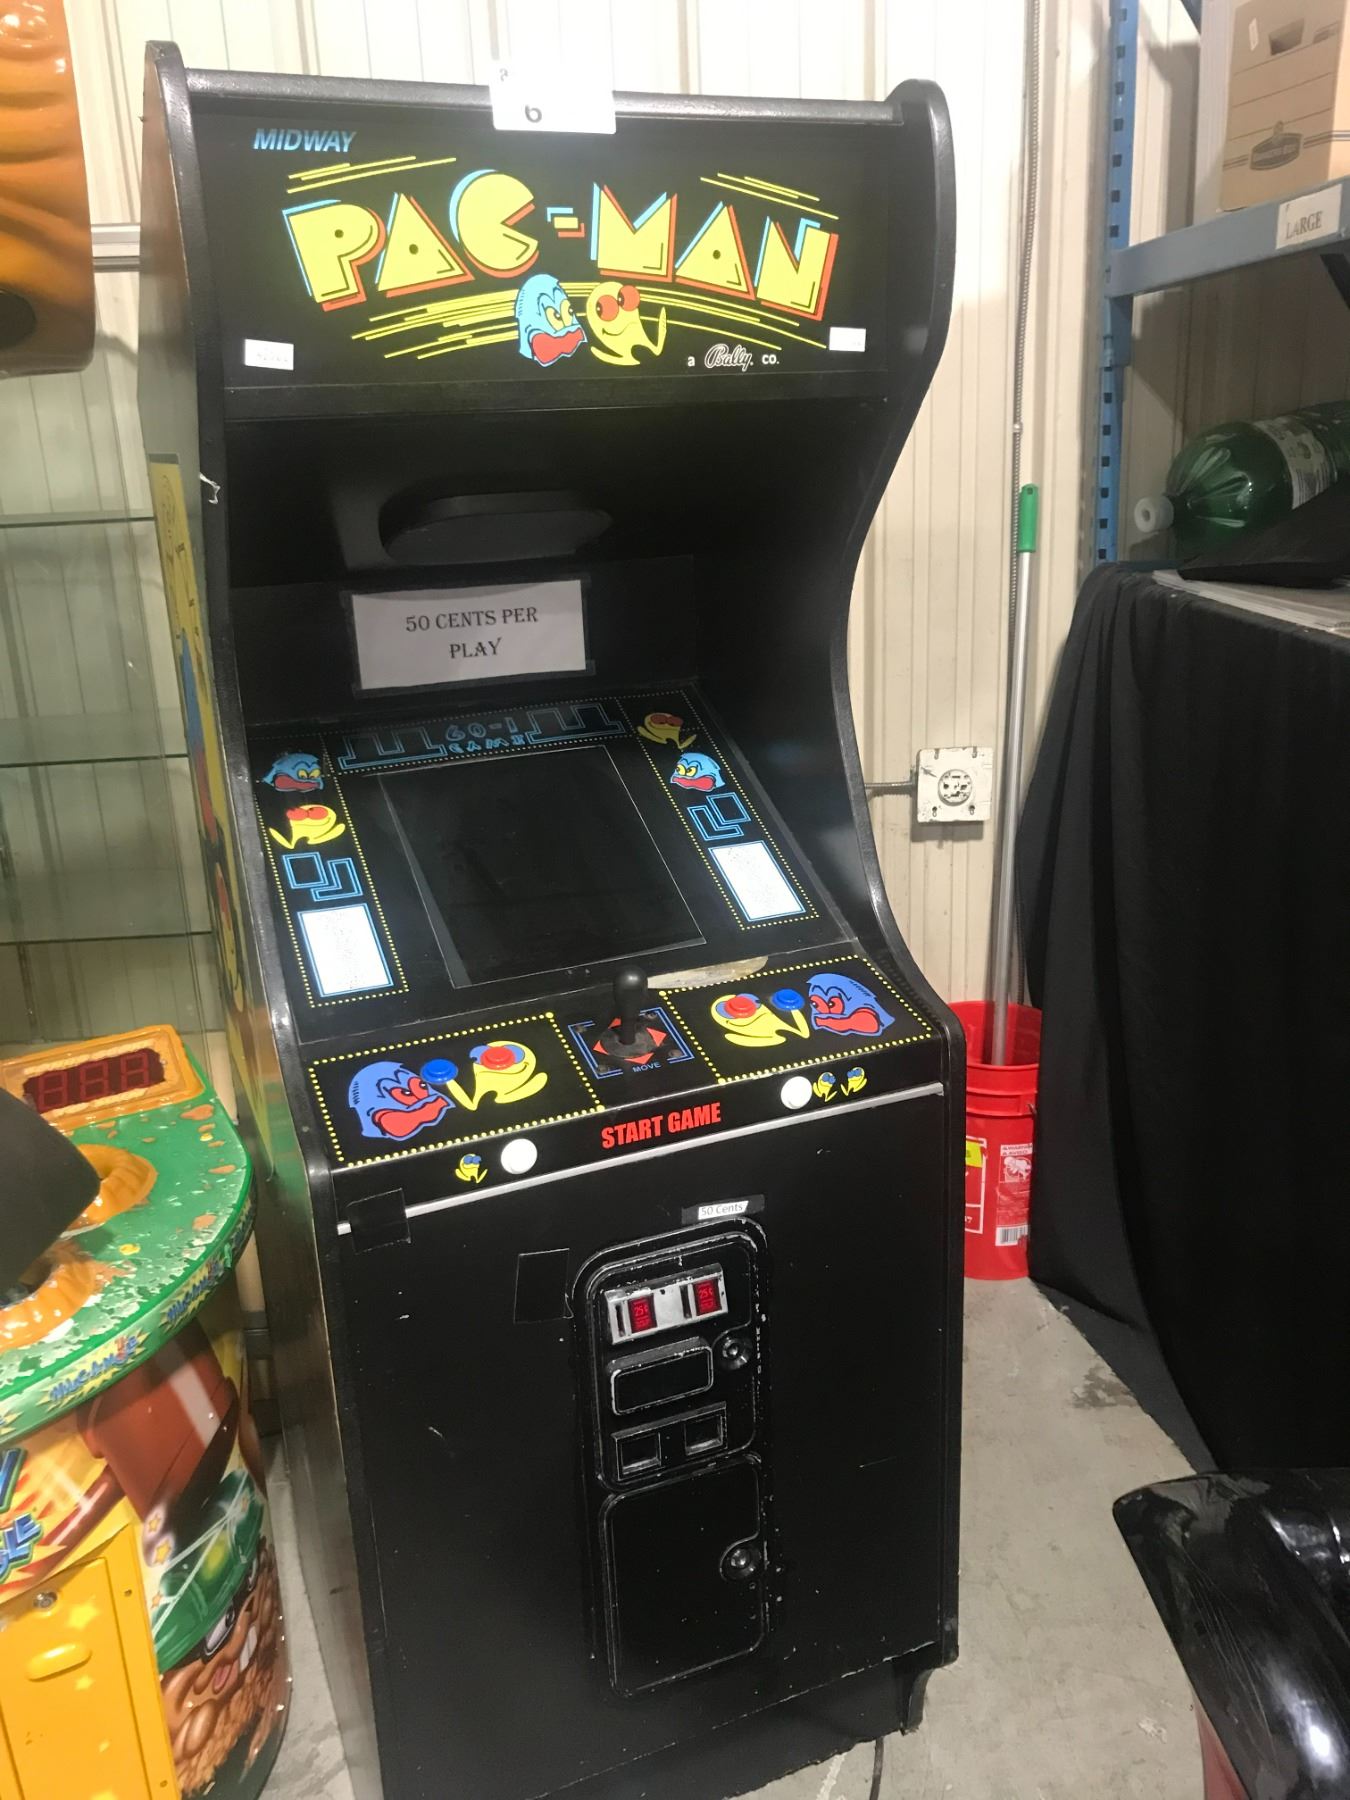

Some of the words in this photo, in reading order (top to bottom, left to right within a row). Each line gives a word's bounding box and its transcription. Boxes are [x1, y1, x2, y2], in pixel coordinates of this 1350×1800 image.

[253, 128, 357, 152] MIDWAY
[1285, 211, 1323, 240] LARGE
[282, 169, 839, 321] PAC-MAN
[687, 356, 695, 367] a
[405, 615, 431, 632] 50
[435, 609, 498, 630] CENTS
[502, 606, 539, 624] PER
[449, 637, 502, 659] PLAY
[632, 1061, 661, 1072] MOVE
[601, 1115, 663, 1149] START
[667, 1102, 721, 1133] GAME
[701, 1207, 714, 1216] 50
[716, 1203, 743, 1214] Cents
